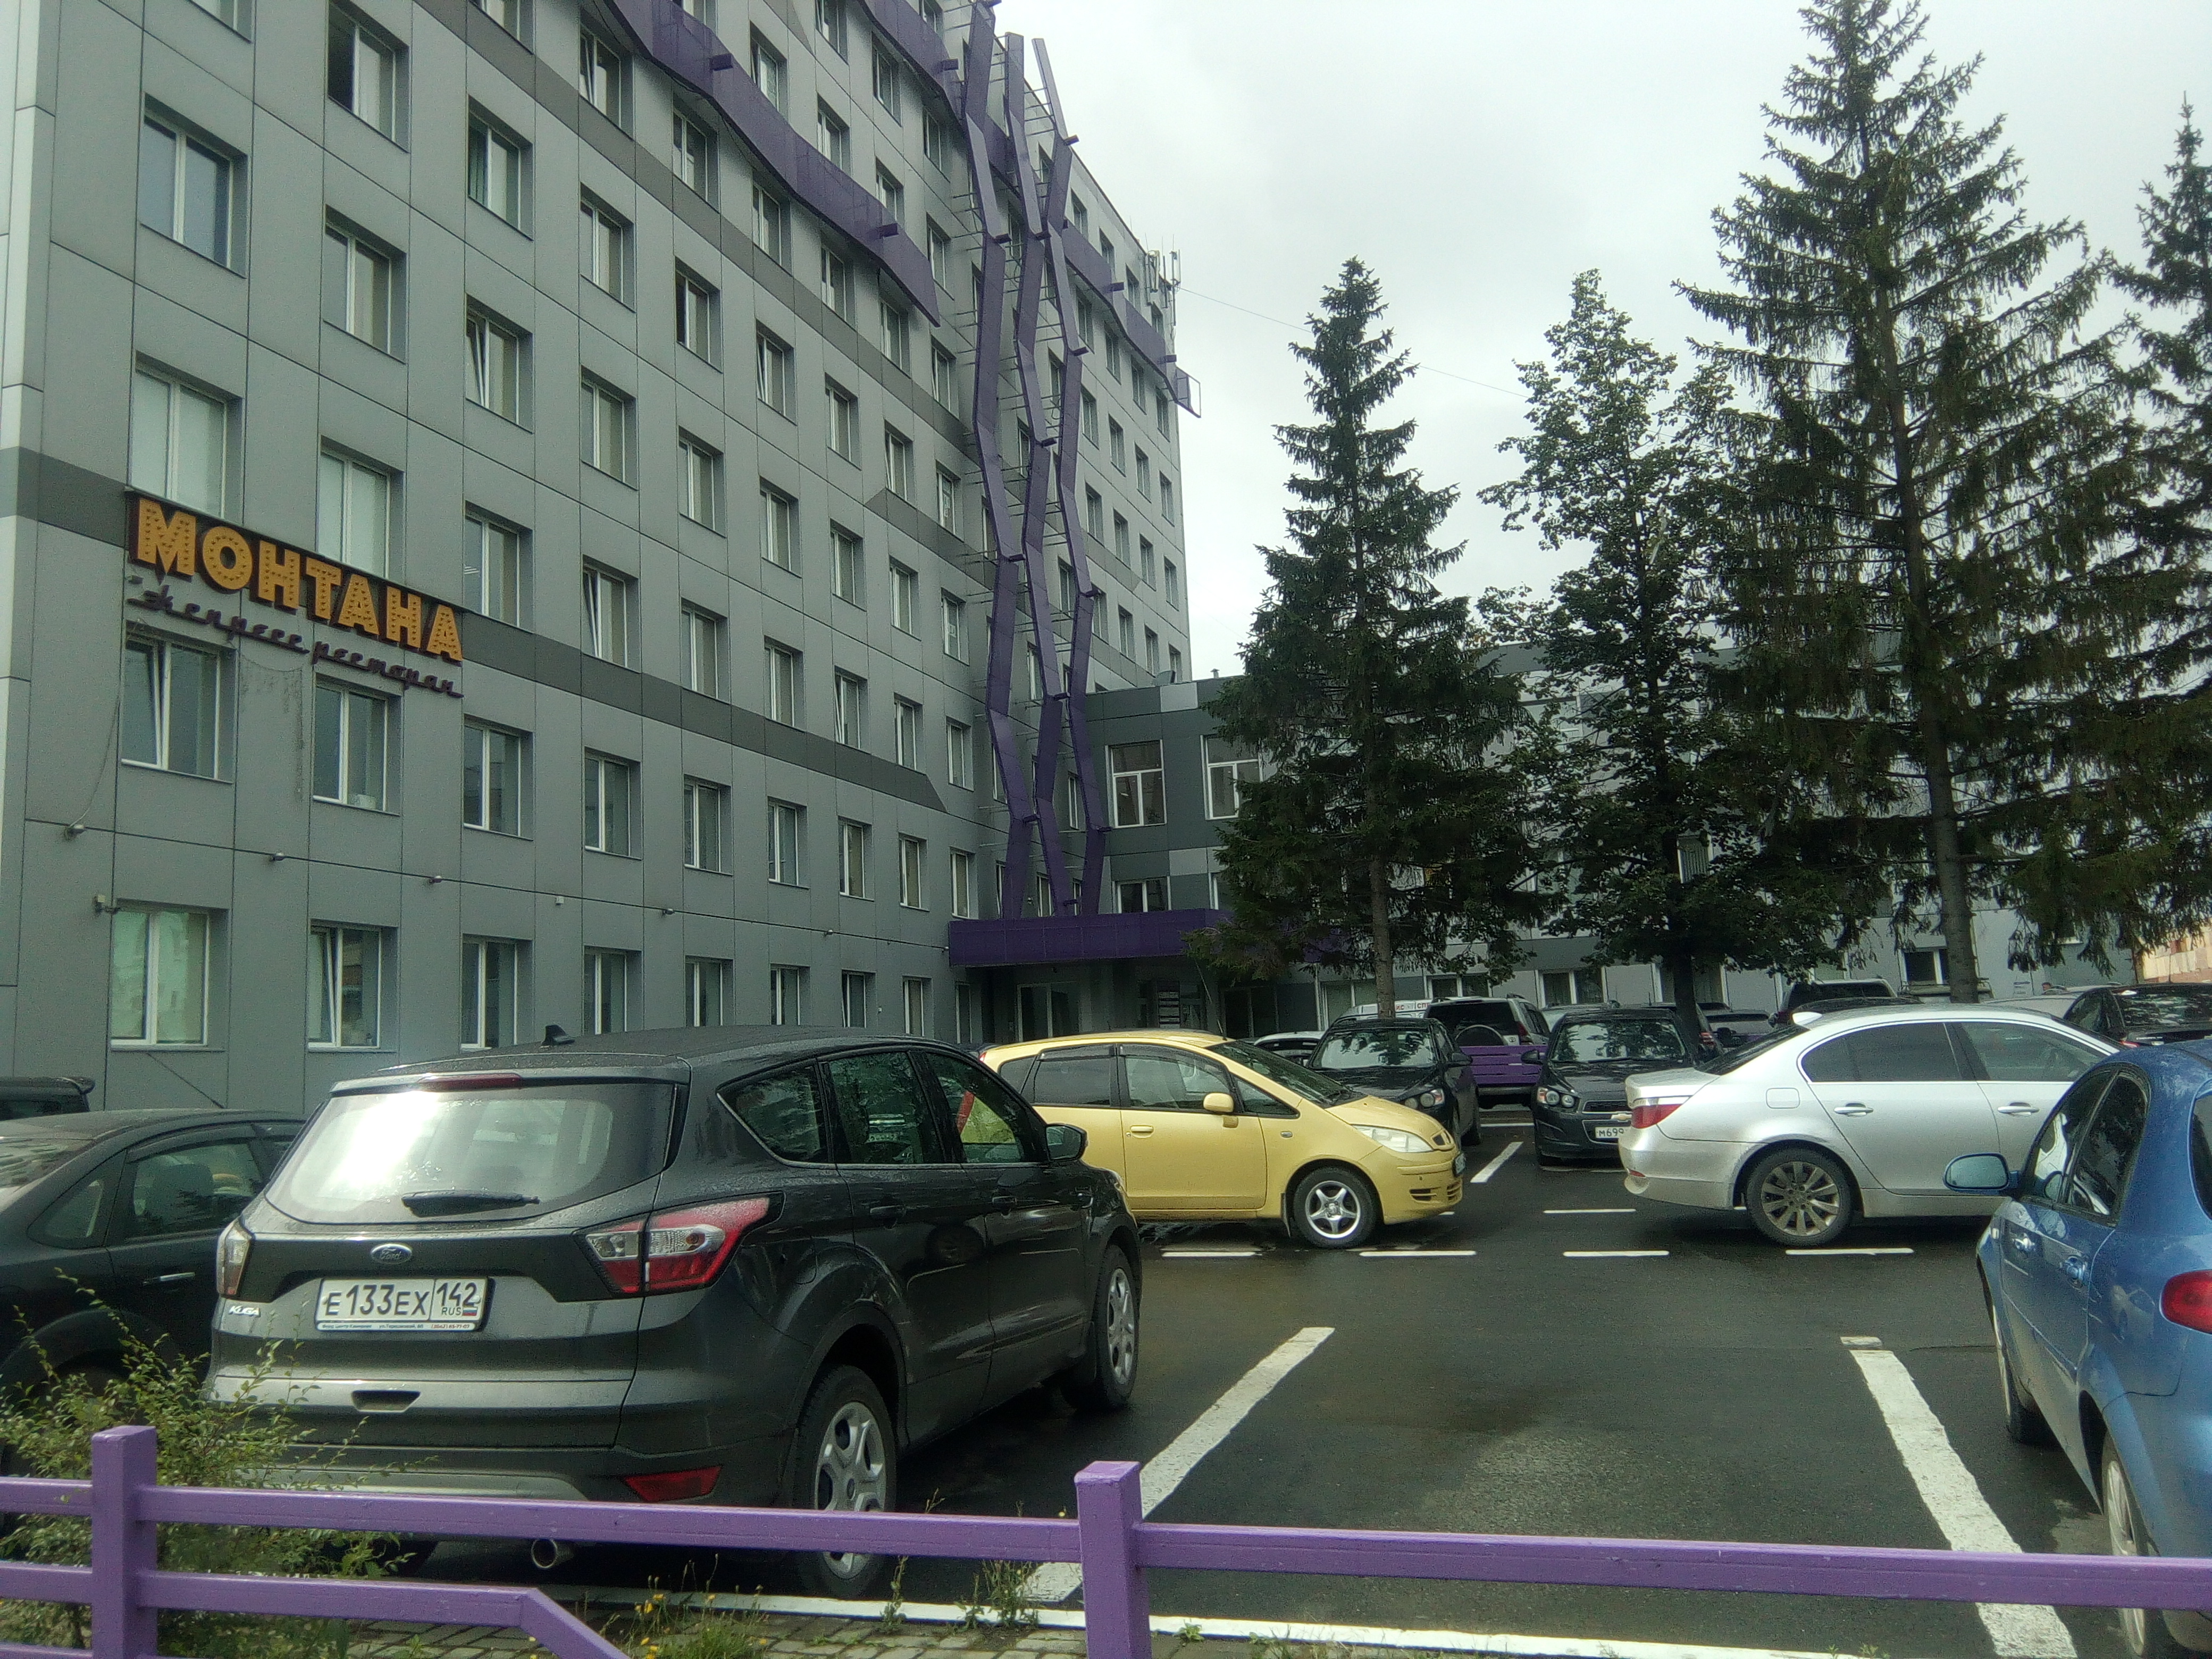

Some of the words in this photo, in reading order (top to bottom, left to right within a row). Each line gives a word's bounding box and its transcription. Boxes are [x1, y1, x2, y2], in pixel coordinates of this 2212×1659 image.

[131, 497, 464, 666] МОНТАНА
[312, 641, 465, 698] ресторан
[380, 1248, 404, 1260] Ford
[229, 1305, 261, 1316] KUGA
[324, 1284, 430, 1316] Е133ЕХ
[436, 1282, 480, 1307] 142
[441, 1306, 462, 1316] RUS
